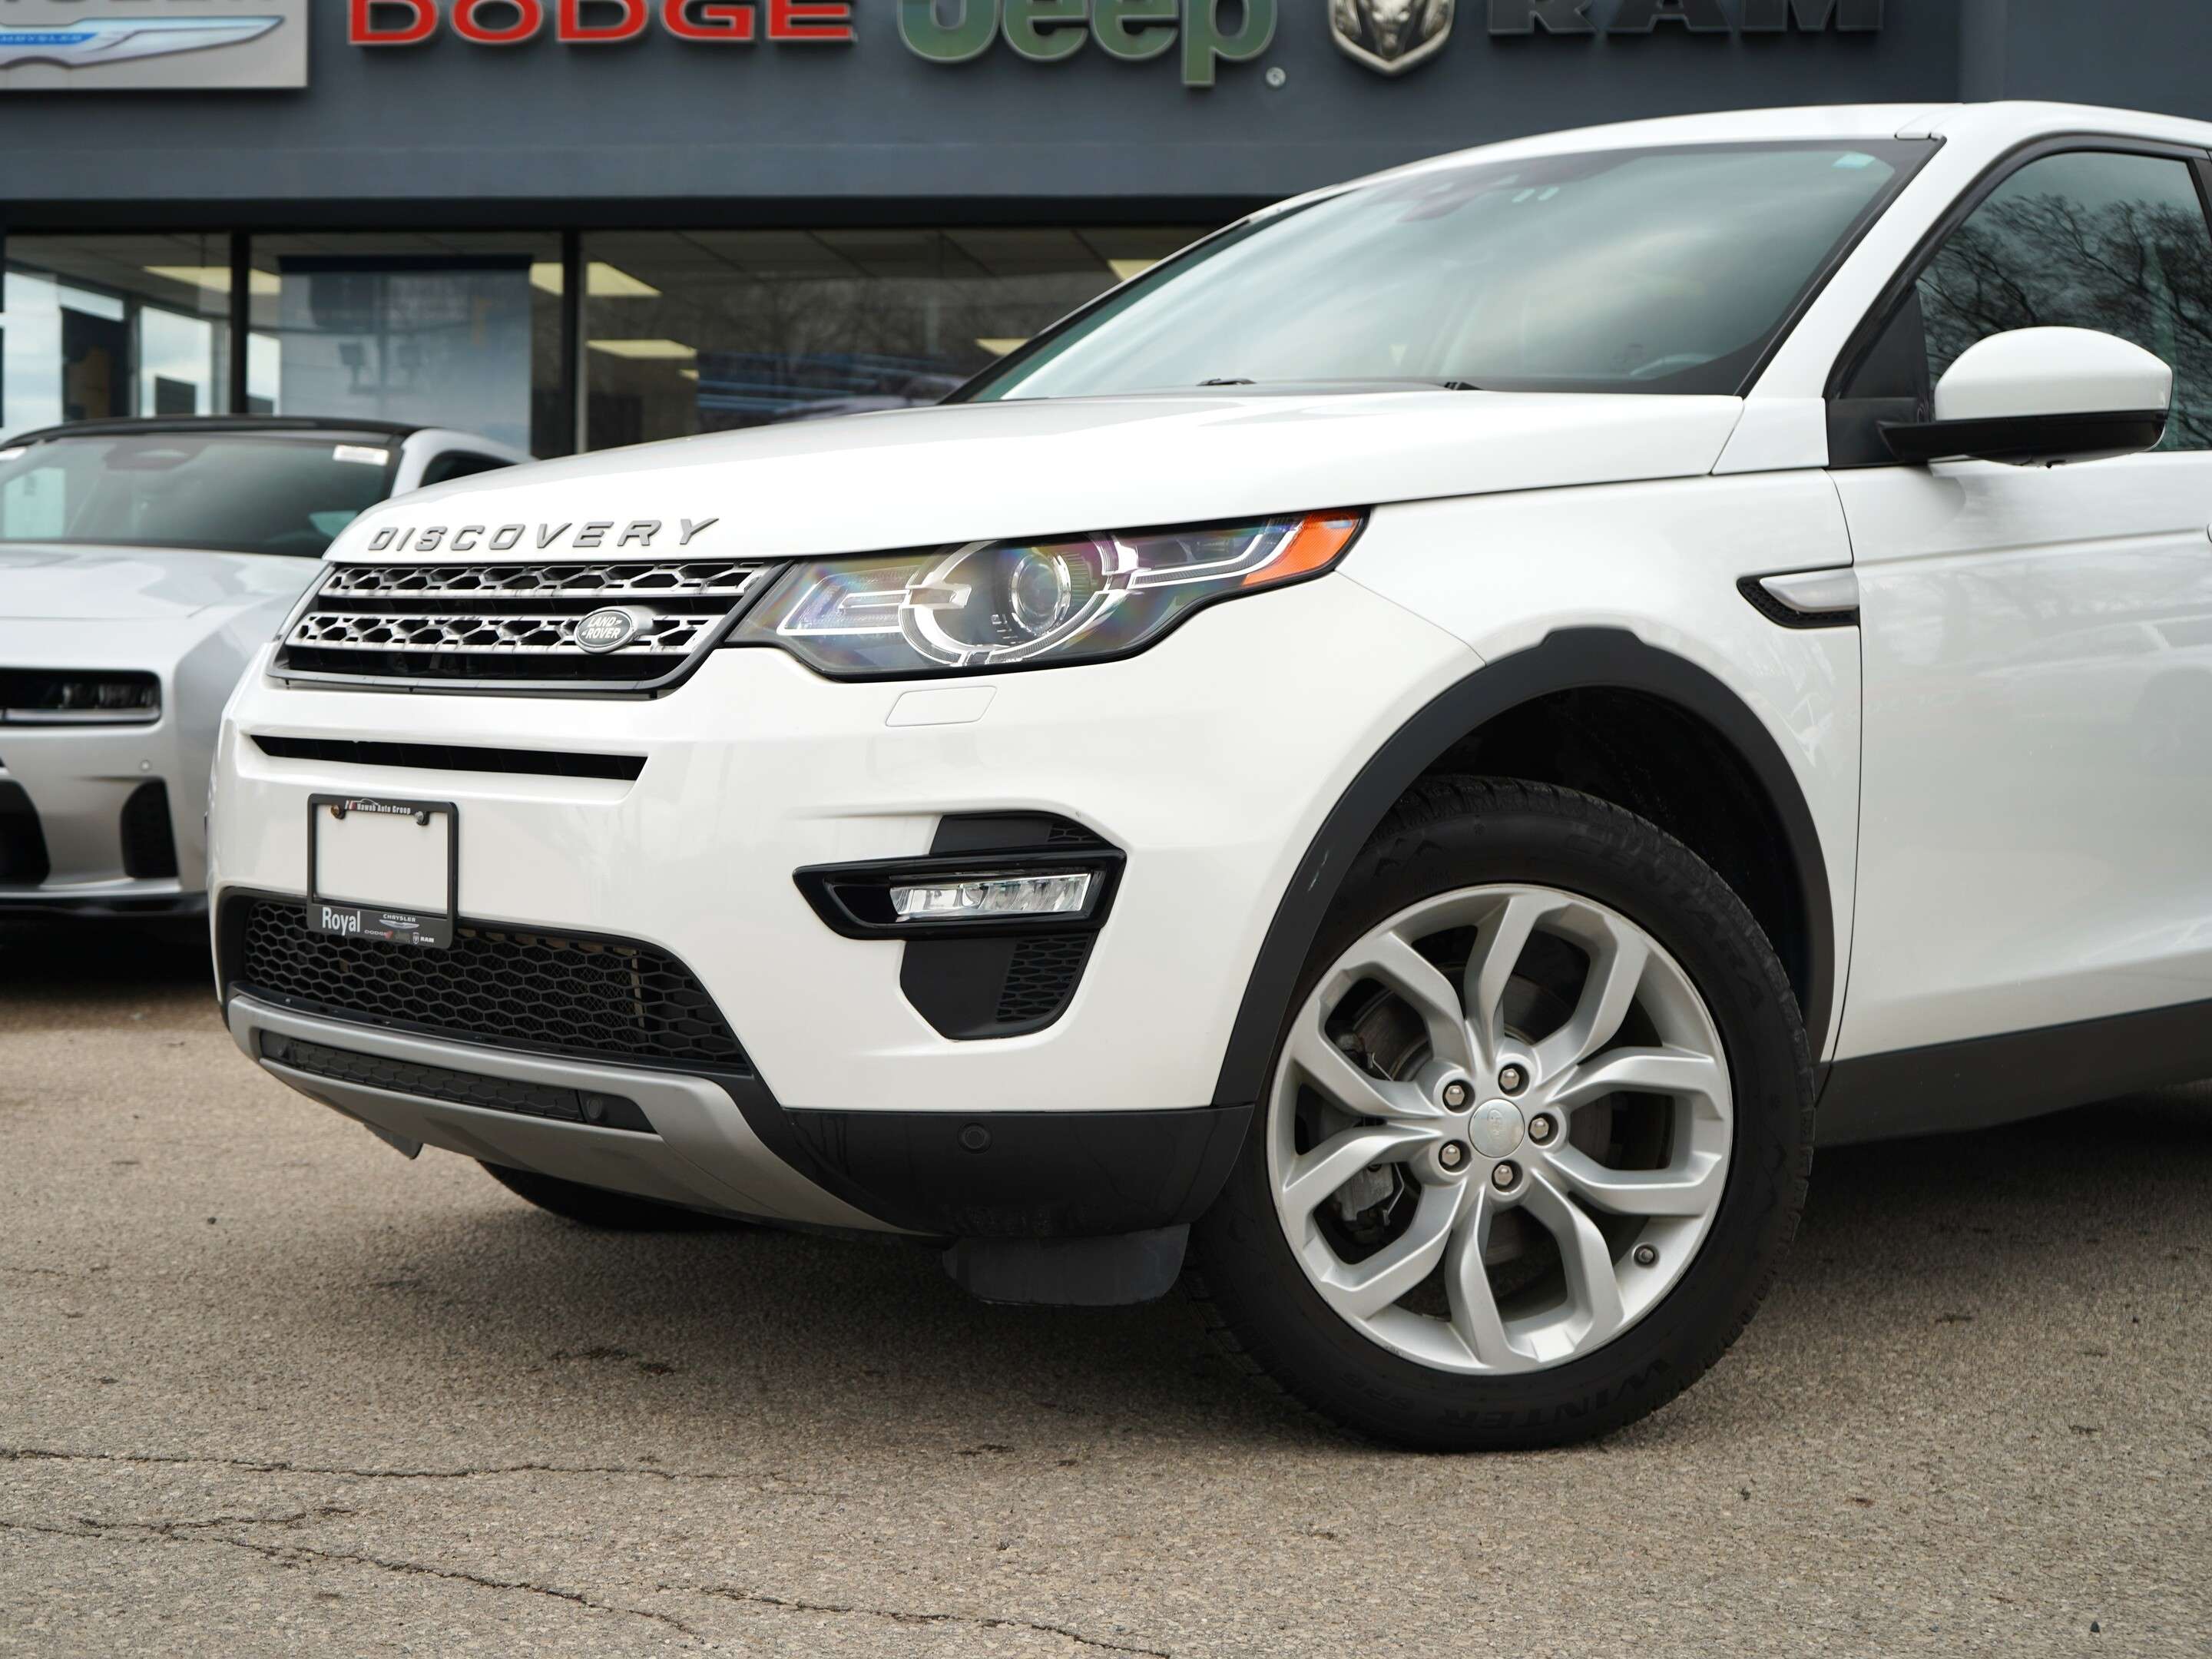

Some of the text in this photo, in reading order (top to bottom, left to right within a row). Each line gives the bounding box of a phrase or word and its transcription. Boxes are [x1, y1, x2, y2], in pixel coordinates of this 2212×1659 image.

[348, 0, 854, 44] DODGE
[368, 518, 720, 551] DISCOVERY
[587, 616, 616, 628] LAND
[584, 628, 621, 639] ROVER
[377, 804, 391, 813] Auto
[392, 805, 411, 815] Group
[322, 906, 361, 936] Royal
[382, 913, 416, 922] CHRYSLER
